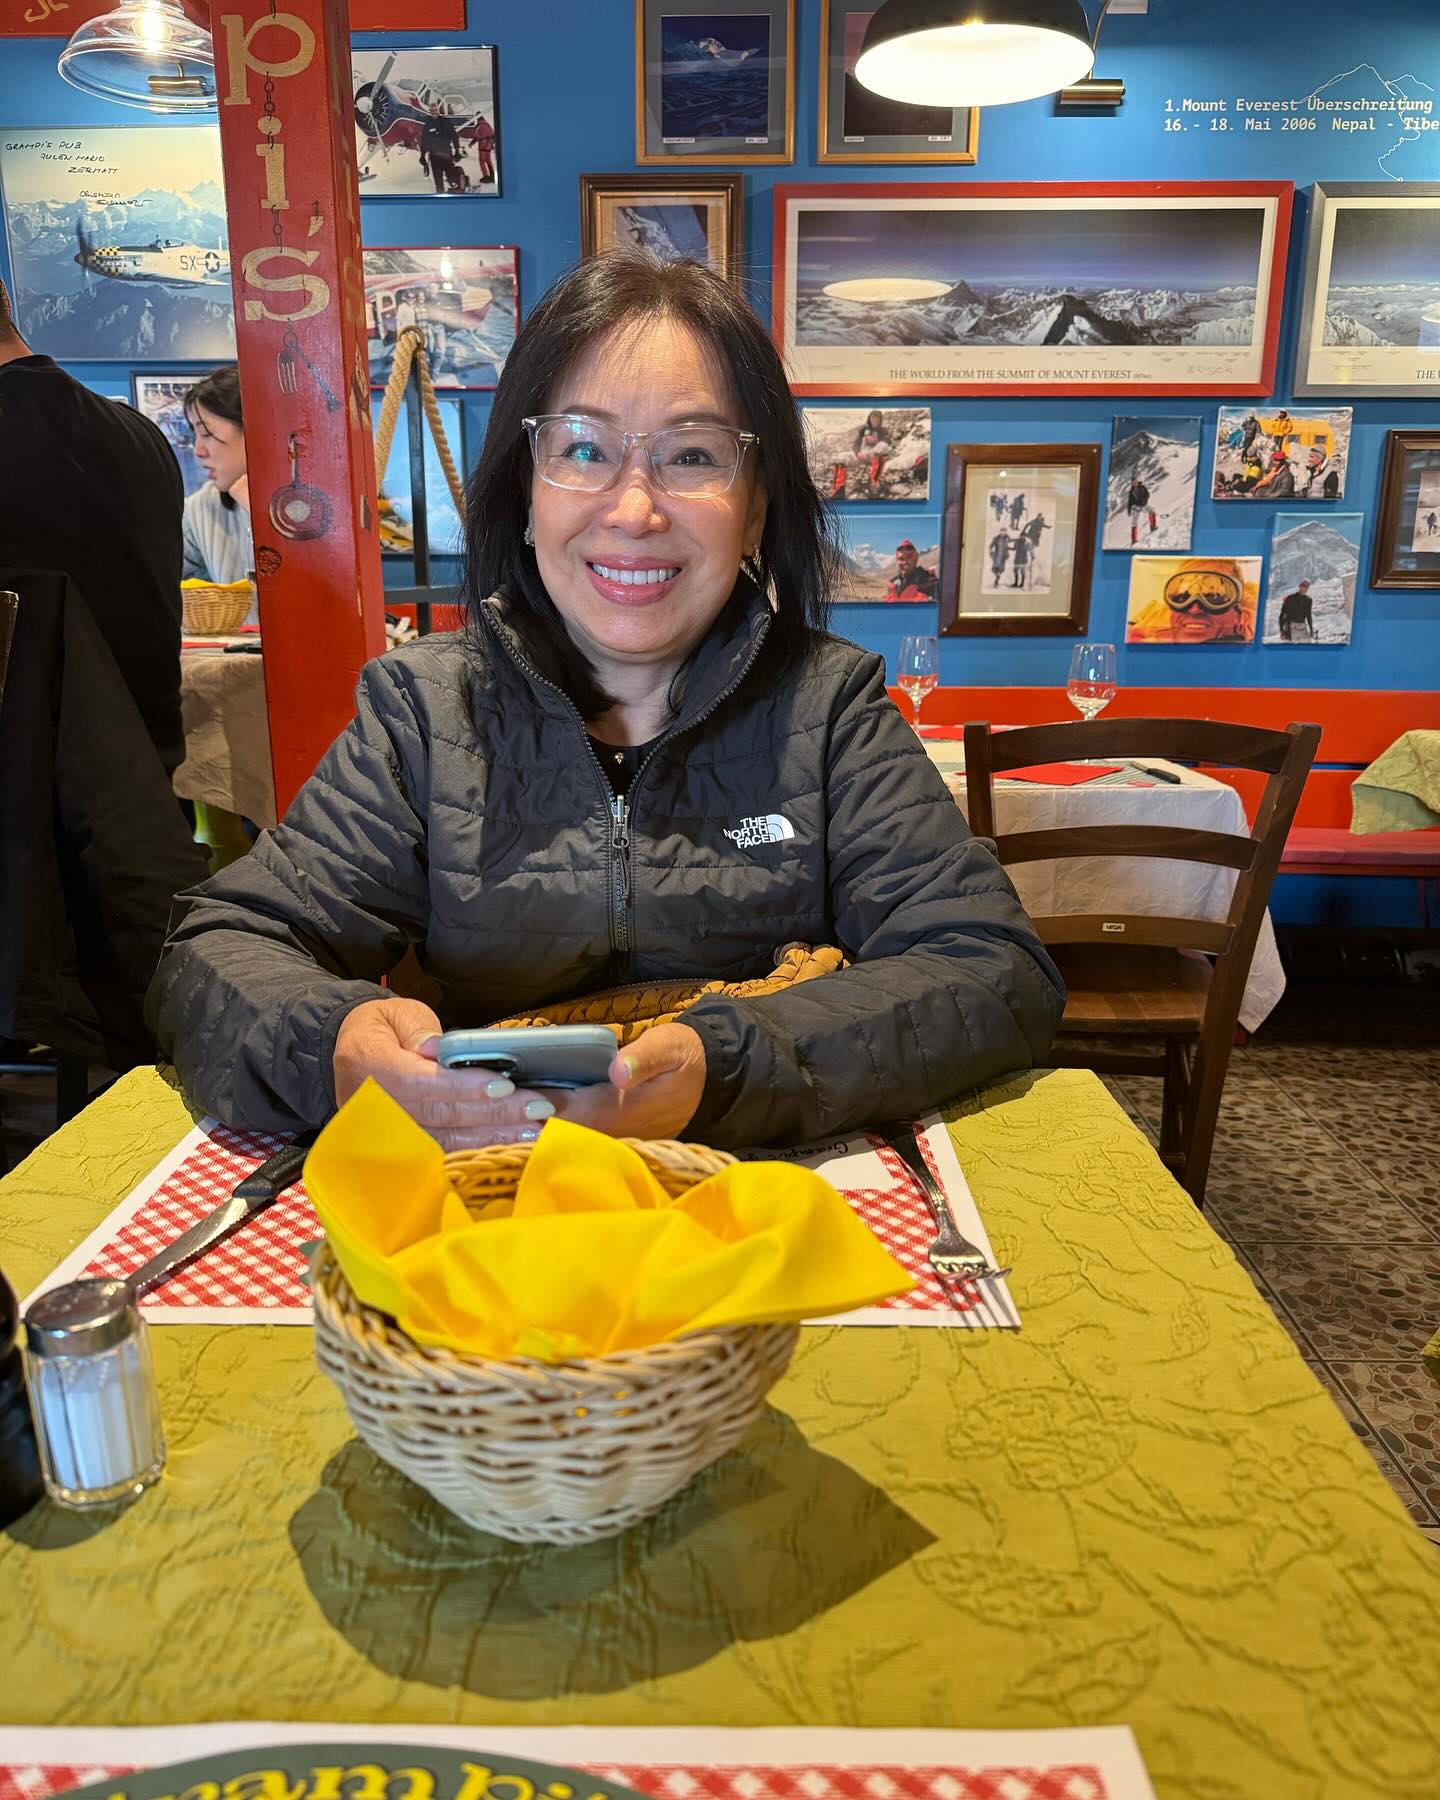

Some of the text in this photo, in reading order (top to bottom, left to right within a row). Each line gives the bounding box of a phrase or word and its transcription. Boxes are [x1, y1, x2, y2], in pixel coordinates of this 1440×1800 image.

[1236, 99, 1298, 112] Everest
[1307, 97, 1433, 113] Überschreitung
[1210, 118, 1234, 131] 18.
[1245, 118, 1272, 131] Mai
[1281, 118, 1317, 131] 2006
[1332, 118, 1376, 134] Nepal
[180, 255, 197, 271] SX
[889, 369, 908, 379] THE
[910, 369, 945, 379] WORLD
[946, 369, 975, 379] FROM
[976, 369, 994, 379] THE
[996, 369, 1035, 379] SUMMIT
[1038, 369, 1050, 379] OF
[1053, 369, 1090, 379] MOUNT
[1091, 369, 1132, 379] EVEREST
[1416, 369, 1436, 379] THE
[740, 816, 767, 828] THE
[723, 824, 768, 840] NORTH
[736, 834, 769, 849] FACE
